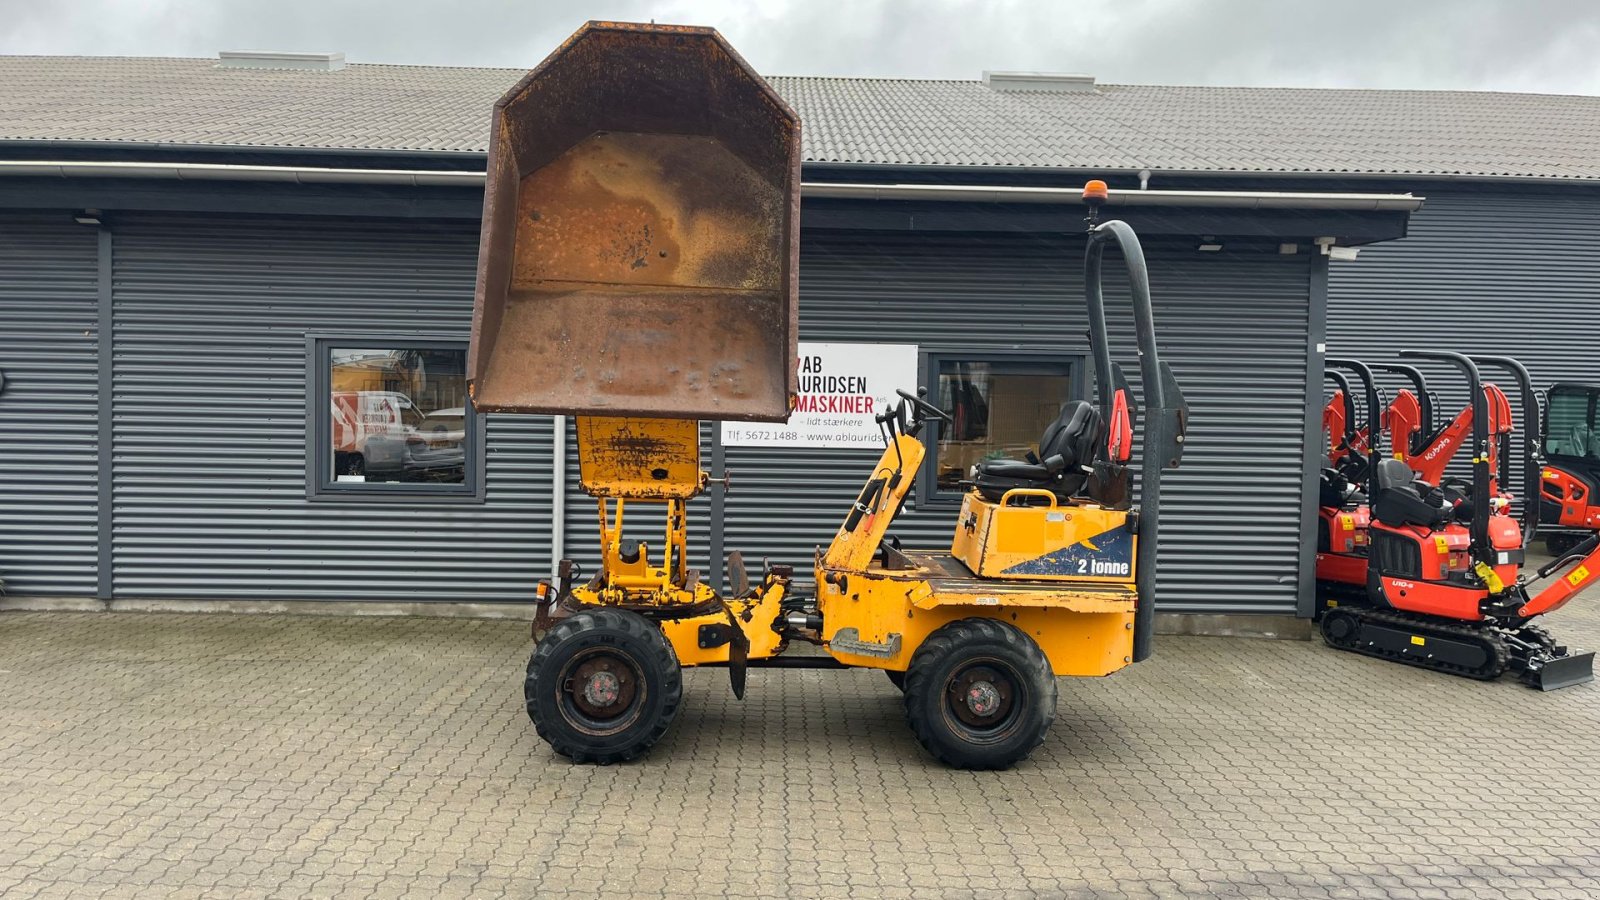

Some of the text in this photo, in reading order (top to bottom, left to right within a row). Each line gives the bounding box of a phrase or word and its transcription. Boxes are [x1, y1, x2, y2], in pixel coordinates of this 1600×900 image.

[803, 356, 822, 373] AB
[795, 395, 874, 414] MASKINER
[806, 417, 821, 426] lidt
[823, 418, 863, 427] stærkere
[727, 430, 743, 441] Tlf.
[746, 431, 770, 441] 5672
[774, 431, 798, 441] 1488
[1424, 438, 1451, 461] Kubota
[1077, 559, 1129, 575] 2 tonne
